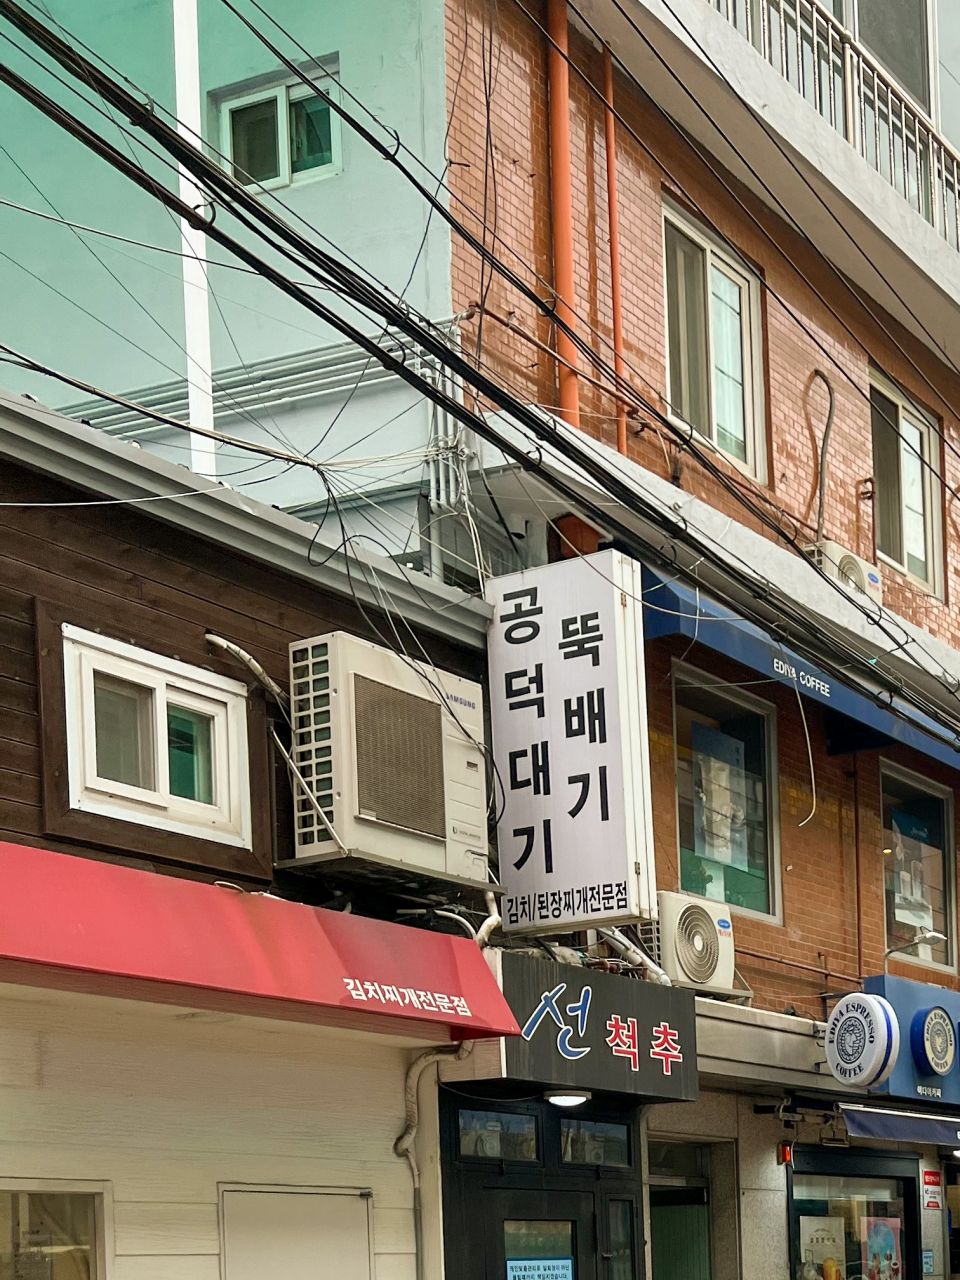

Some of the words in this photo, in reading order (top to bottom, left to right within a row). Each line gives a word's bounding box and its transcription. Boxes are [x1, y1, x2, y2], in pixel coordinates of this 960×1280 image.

[773, 658, 797, 680] EDIYA
[799, 671, 830, 697] COFFEE
[500, 586, 554, 873] 공덕대기
[558, 611, 609, 821] 뚝배기
[507, 880, 627, 924] 김치/된장찌개전문점
[343, 977, 472, 1017] 김치찌개전문점
[829, 1009, 844, 1044] EDIYA
[845, 1002, 875, 1044] ESPRESSO
[605, 1014, 683, 1077] 척추
[835, 1063, 864, 1078] COFFEE
